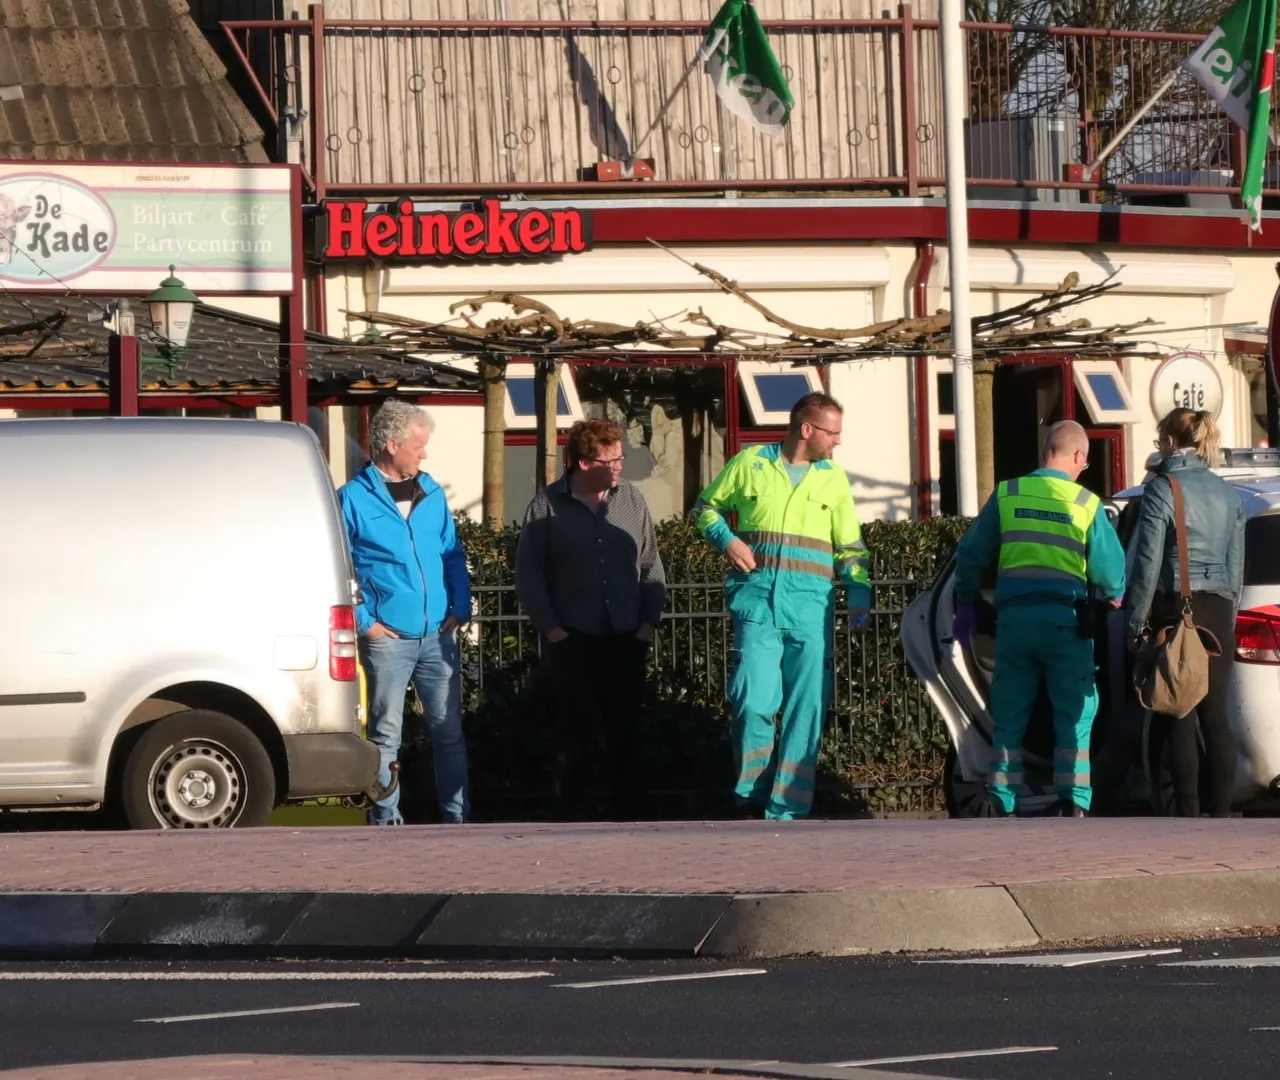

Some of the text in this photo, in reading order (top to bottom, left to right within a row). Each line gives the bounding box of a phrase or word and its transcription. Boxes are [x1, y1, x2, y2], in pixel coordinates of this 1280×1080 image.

[35, 194, 62, 219] De
[133, 205, 268, 228] Biljart Café
[26, 222, 108, 258] Kade
[324, 199, 586, 257] Heineken
[132, 232, 272, 258] Partycentrum
[1173, 382, 1205, 410] Café
